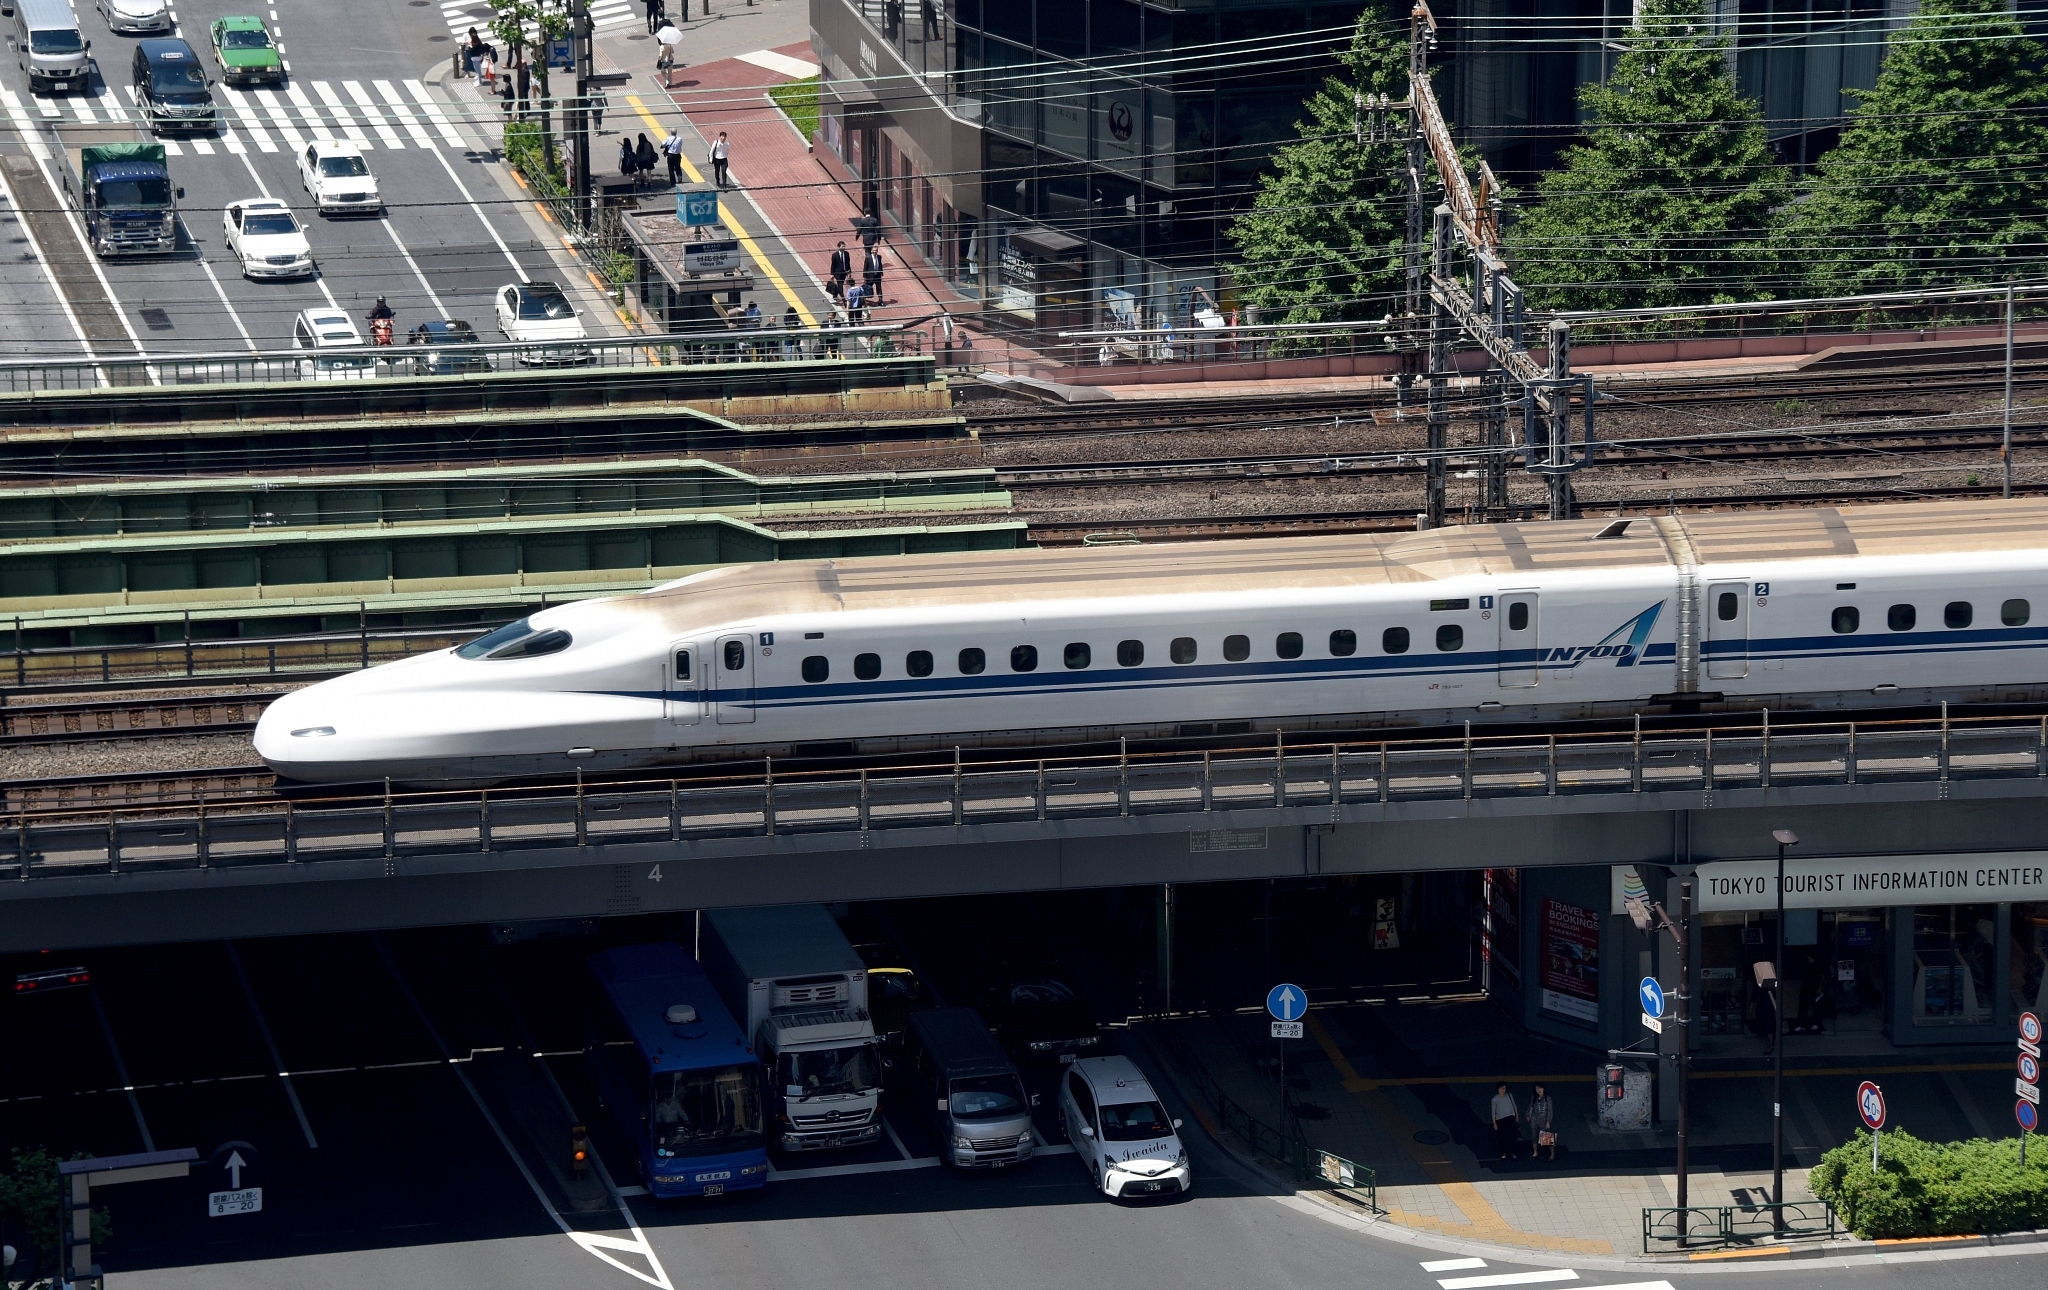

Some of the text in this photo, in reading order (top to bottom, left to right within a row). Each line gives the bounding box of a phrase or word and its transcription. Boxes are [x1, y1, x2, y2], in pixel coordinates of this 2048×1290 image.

[1114, 128, 1128, 138] JAL
[1758, 584, 1766, 595] 2
[1482, 597, 1489, 608] 1
[763, 634, 770, 644] 1
[648, 864, 662, 882] 4
[1710, 876, 1765, 896] TOKYO
[1853, 870, 1968, 890] INFORMATION
[1976, 868, 2043, 886] CENTER
[1550, 900, 1586, 918] TRAVEL
[1550, 910, 1600, 930] BOOKINGS
[1556, 920, 1580, 932] ENGLISH
[2024, 1021, 2037, 1037] 40
[1122, 1142, 1168, 1162] Iwaida
[213, 1191, 258, 1204] 路線バスを除く
